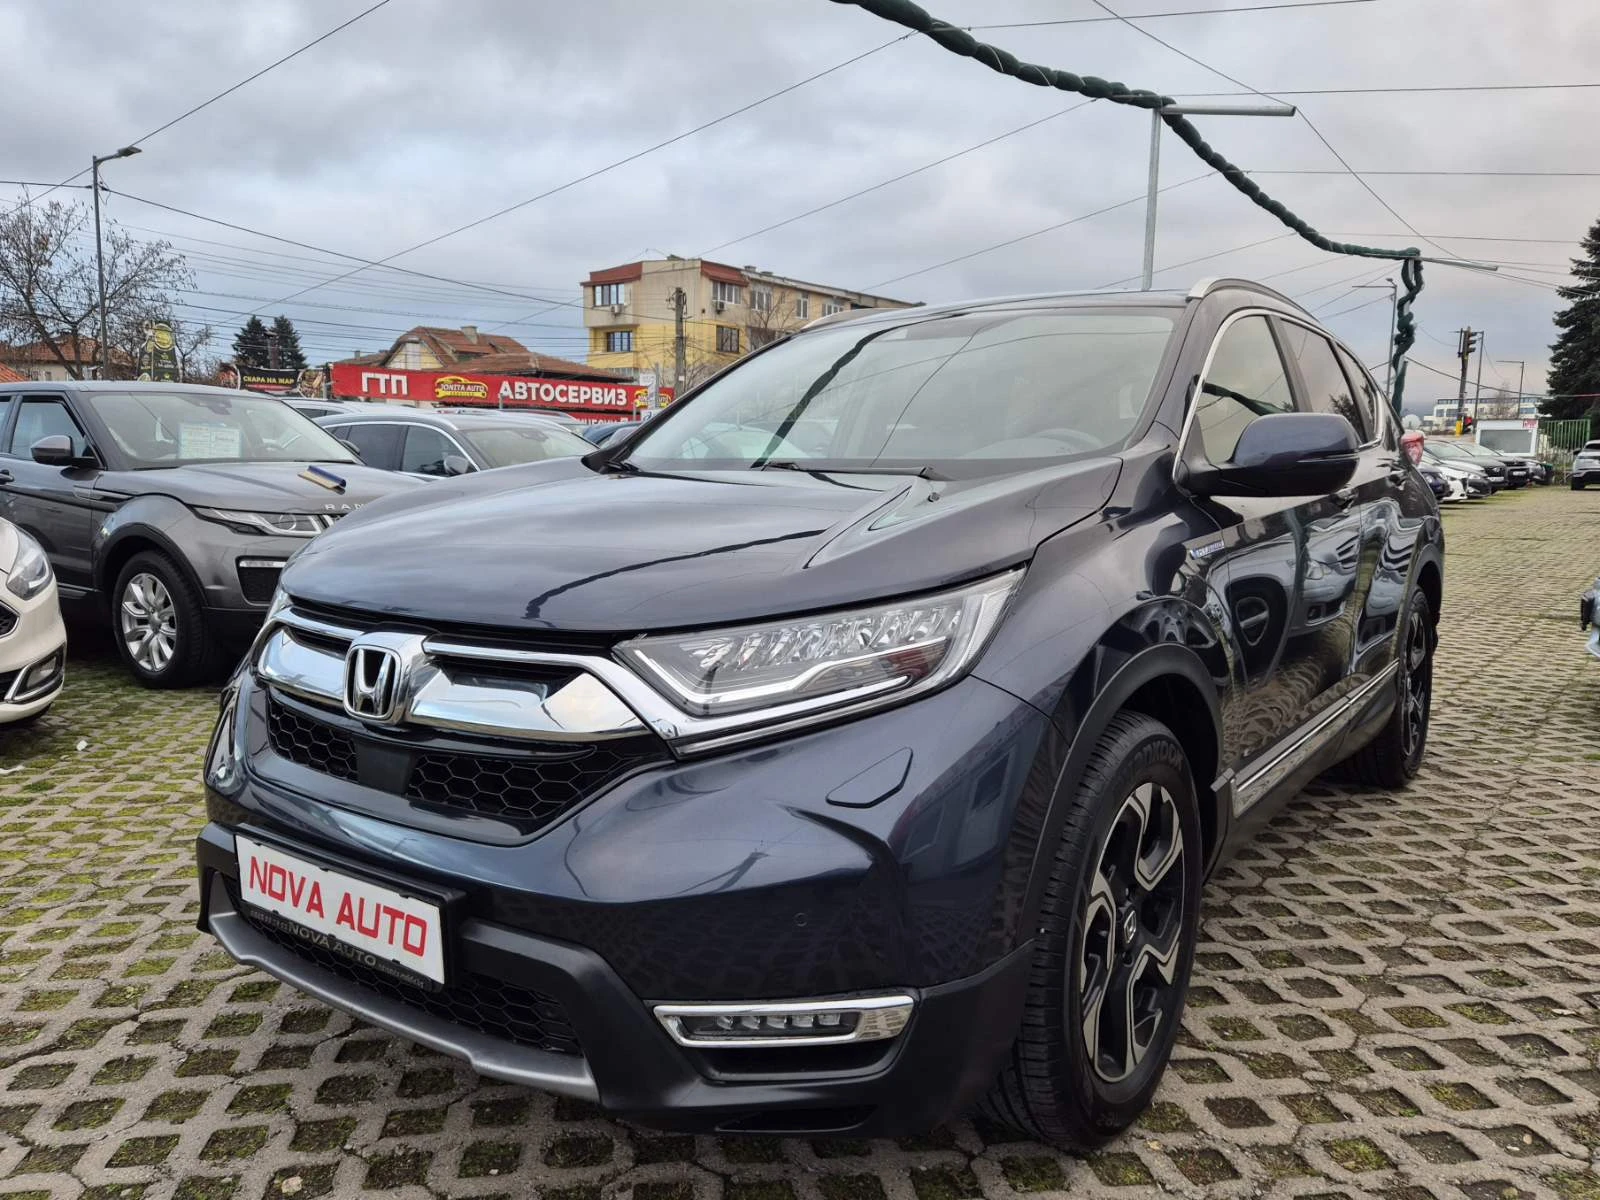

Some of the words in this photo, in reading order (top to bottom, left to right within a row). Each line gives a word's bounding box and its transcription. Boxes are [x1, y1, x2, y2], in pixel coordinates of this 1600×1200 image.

[243, 375, 266, 383] СКАРА
[361, 372, 408, 395] ГТП
[466, 385, 485, 393] AUTO
[499, 381, 627, 406] АВТОСЕРВИЗ
[250, 856, 324, 919] NOVA
[336, 892, 427, 957] AUTO
[289, 920, 330, 946] NOVA
[333, 943, 376, 967] AUTO
